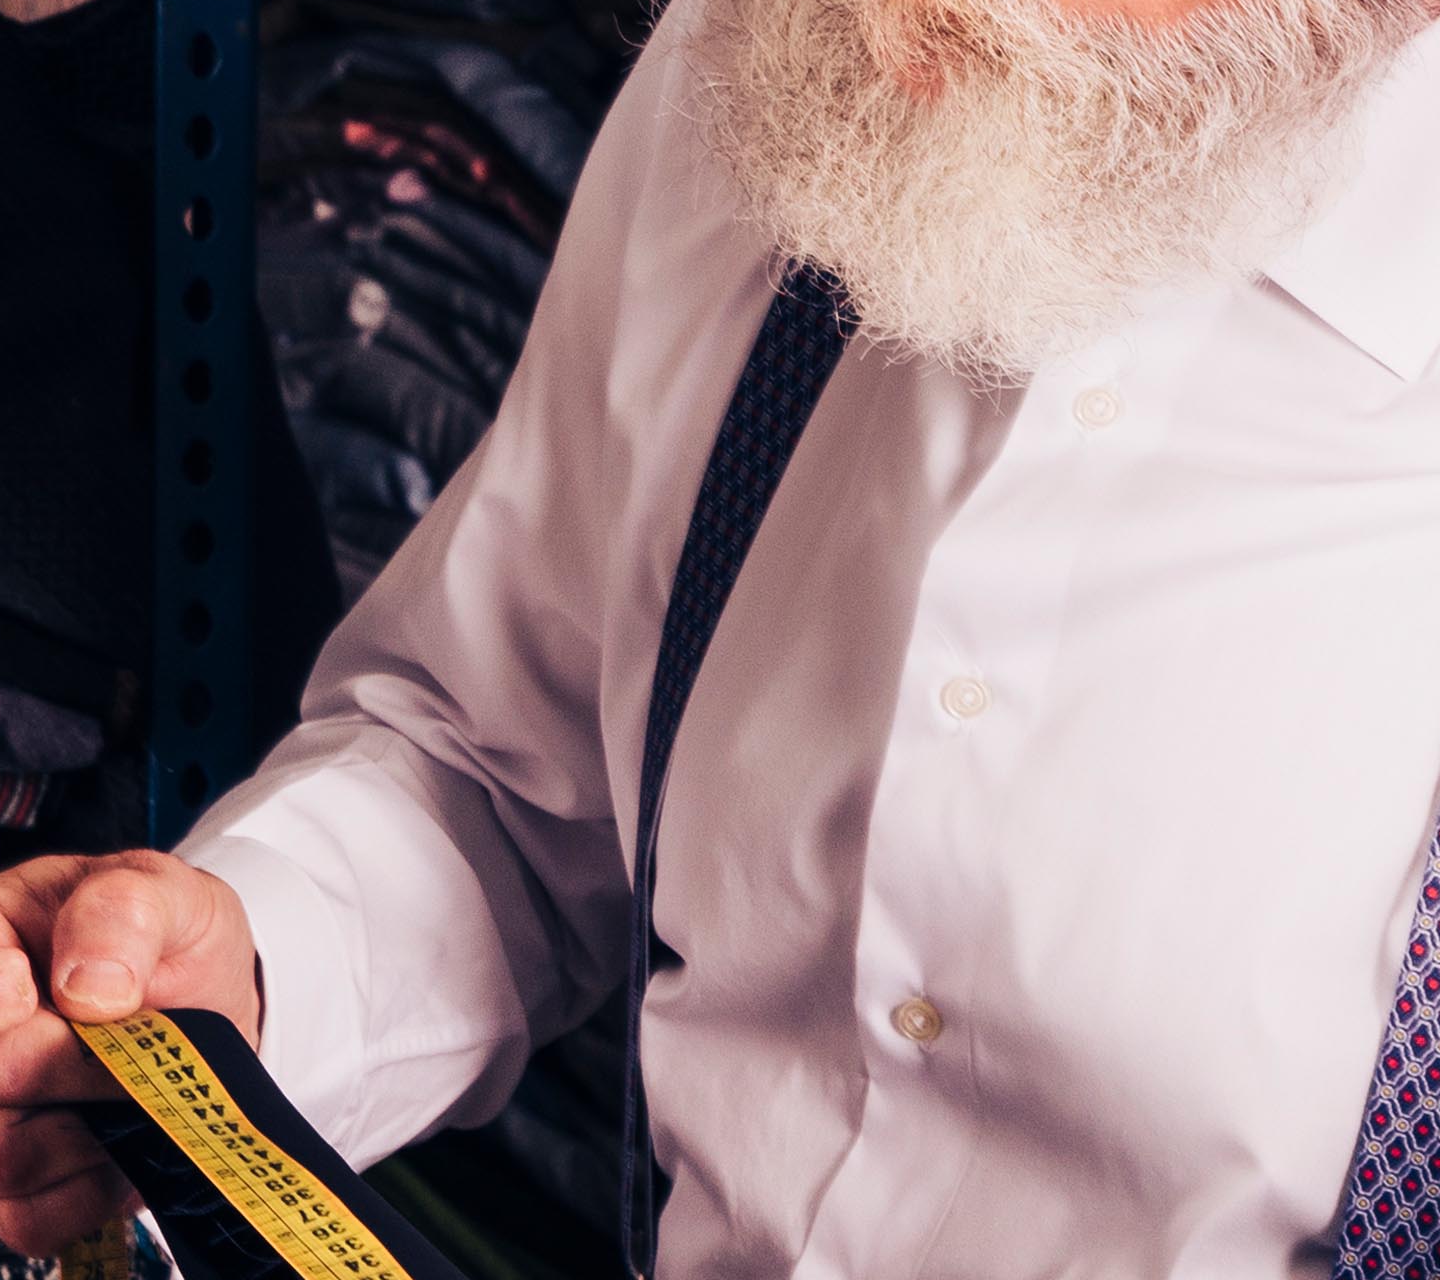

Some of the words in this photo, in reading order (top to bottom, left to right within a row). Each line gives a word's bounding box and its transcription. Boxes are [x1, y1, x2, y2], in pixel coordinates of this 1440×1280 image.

[136, 1031, 167, 1050] 48
[152, 1046, 181, 1067] 47
[164, 1065, 196, 1084] 46
[179, 1084, 209, 1102] 45
[192, 1103, 224, 1120] 44
[208, 1121, 239, 1136] 43
[221, 1136, 254, 1150] 42
[238, 1149, 268, 1163] 41
[249, 1161, 282, 1178] 40
[266, 1175, 300, 1191] 39
[281, 1189, 314, 1206] 38
[298, 1204, 330, 1224] 37
[312, 1222, 346, 1240] 36
[328, 1238, 364, 1258] 35
[344, 1254, 380, 1273] 34
